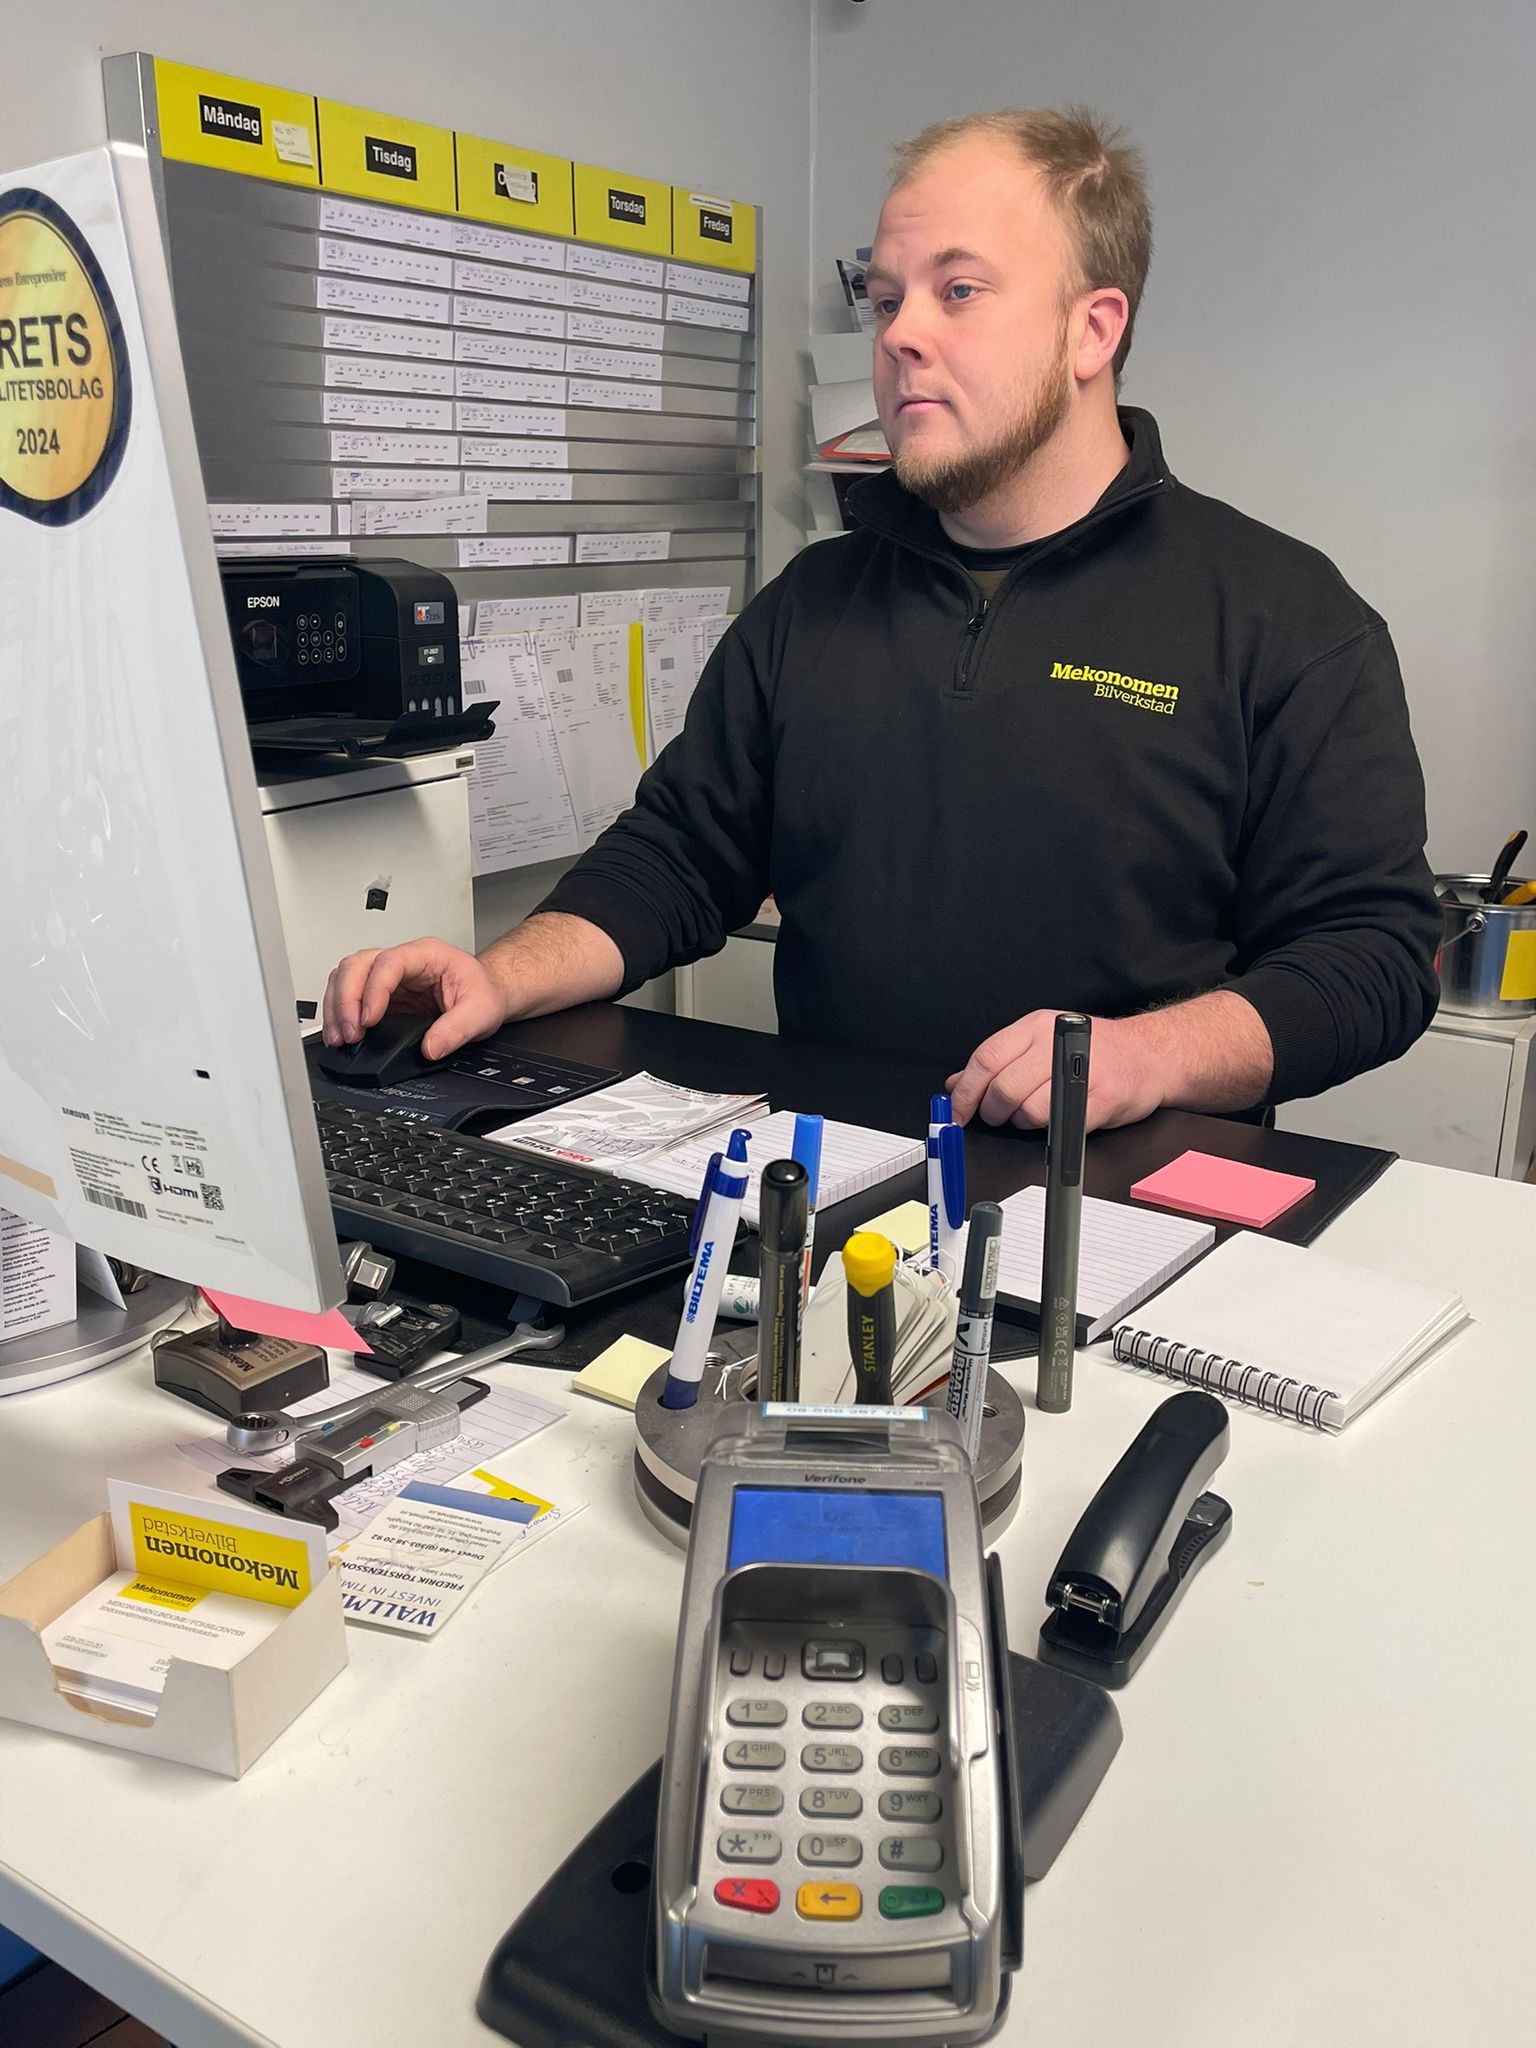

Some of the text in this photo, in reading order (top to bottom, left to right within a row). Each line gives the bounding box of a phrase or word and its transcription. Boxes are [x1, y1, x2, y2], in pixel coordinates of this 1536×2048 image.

[203, 105, 260, 137] Måndag
[372, 146, 412, 172] Tisdag
[610, 196, 645, 218] Torsdag
[703, 216, 730, 236] Fredag
[16, 428, 61, 455] 2024
[247, 596, 280, 609] EPSON
[1050, 662, 1179, 700] Mekonomen
[1094, 683, 1175, 715] Bilverkstad
[688, 1241, 714, 1313] BILTEMA
[863, 1315, 876, 1372] STANLEY
[951, 1357, 965, 1419] BOARD
[803, 1473, 866, 1486] Verifone
[143, 1517, 237, 1553] Bilverkstad
[383, 1536, 395, 1544] 20
[439, 1547, 457, 1555] +46
[457, 1550, 484, 1561] Direct
[144, 1535, 299, 1590] Mekonomen
[341, 1562, 465, 1592] FREDRIK TORSTENSSON
[132, 1583, 197, 1604] Mekonomen
[372, 1585, 387, 1596] IN
[389, 1591, 441, 1607] INVEST
[741, 1702, 769, 1718] 1 QZ
[815, 1705, 827, 1721] 2
[889, 1708, 924, 1724] 3 DEF
[736, 1744, 770, 1761] 4 GHI
[814, 1748, 848, 1765] 5 JKL
[889, 1749, 929, 1767] 6 MNO
[735, 1788, 770, 1806] 7 PRS
[813, 1791, 849, 1808] 8 TUV
[890, 1793, 929, 1811] 9 WXY
[811, 1837, 823, 1856] 0
